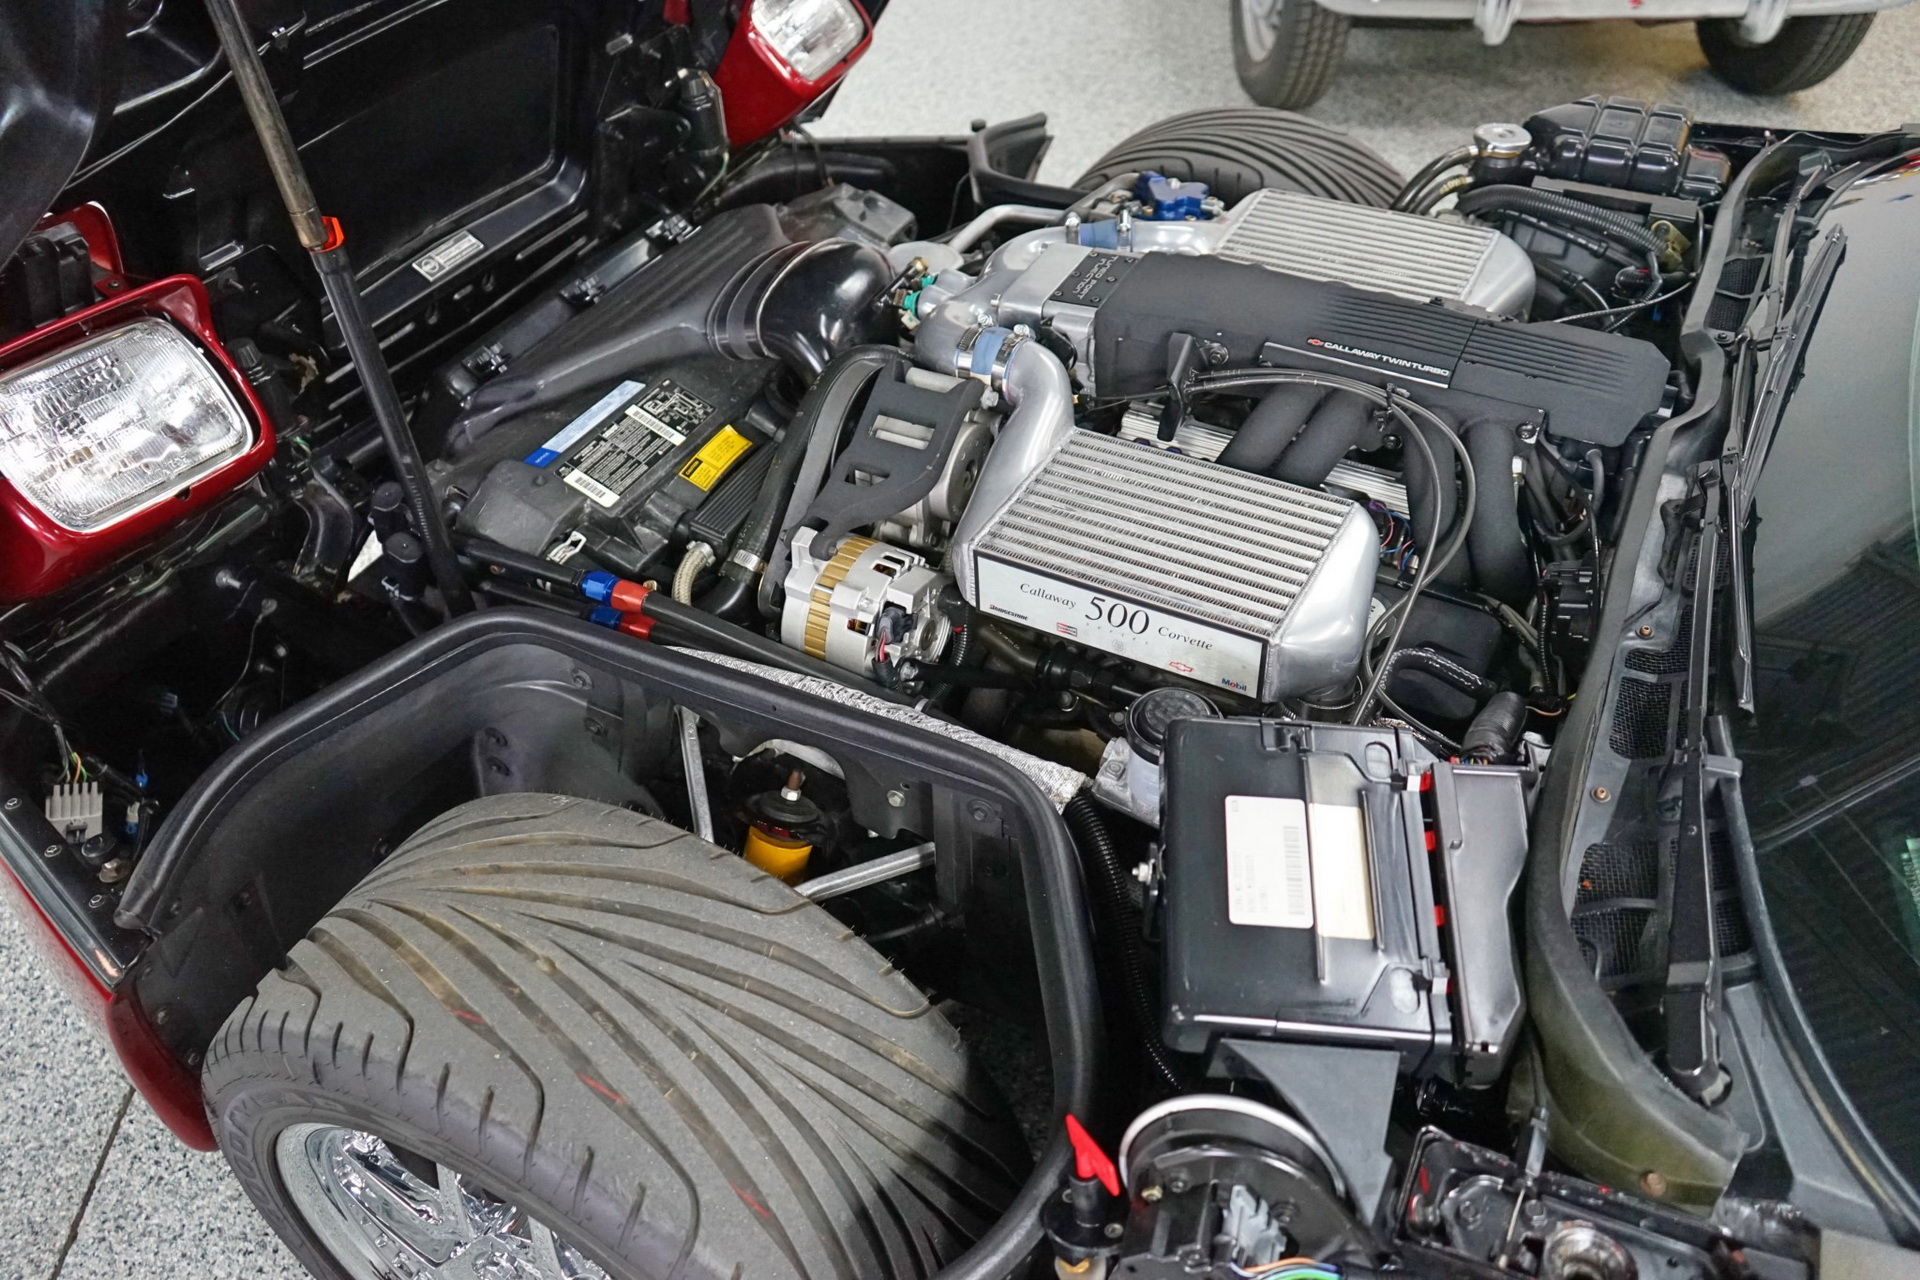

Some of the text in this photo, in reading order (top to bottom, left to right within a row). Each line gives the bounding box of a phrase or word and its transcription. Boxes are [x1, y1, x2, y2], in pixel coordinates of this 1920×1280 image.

[1072, 258, 1108, 294] INJECTION
[1077, 255, 1119, 300] TUNED PORT
[1324, 342, 1381, 361] CALLAWAY
[1019, 582, 1213, 651] Callaway 500 Corvette
[1221, 677, 1248, 693] Mobil
